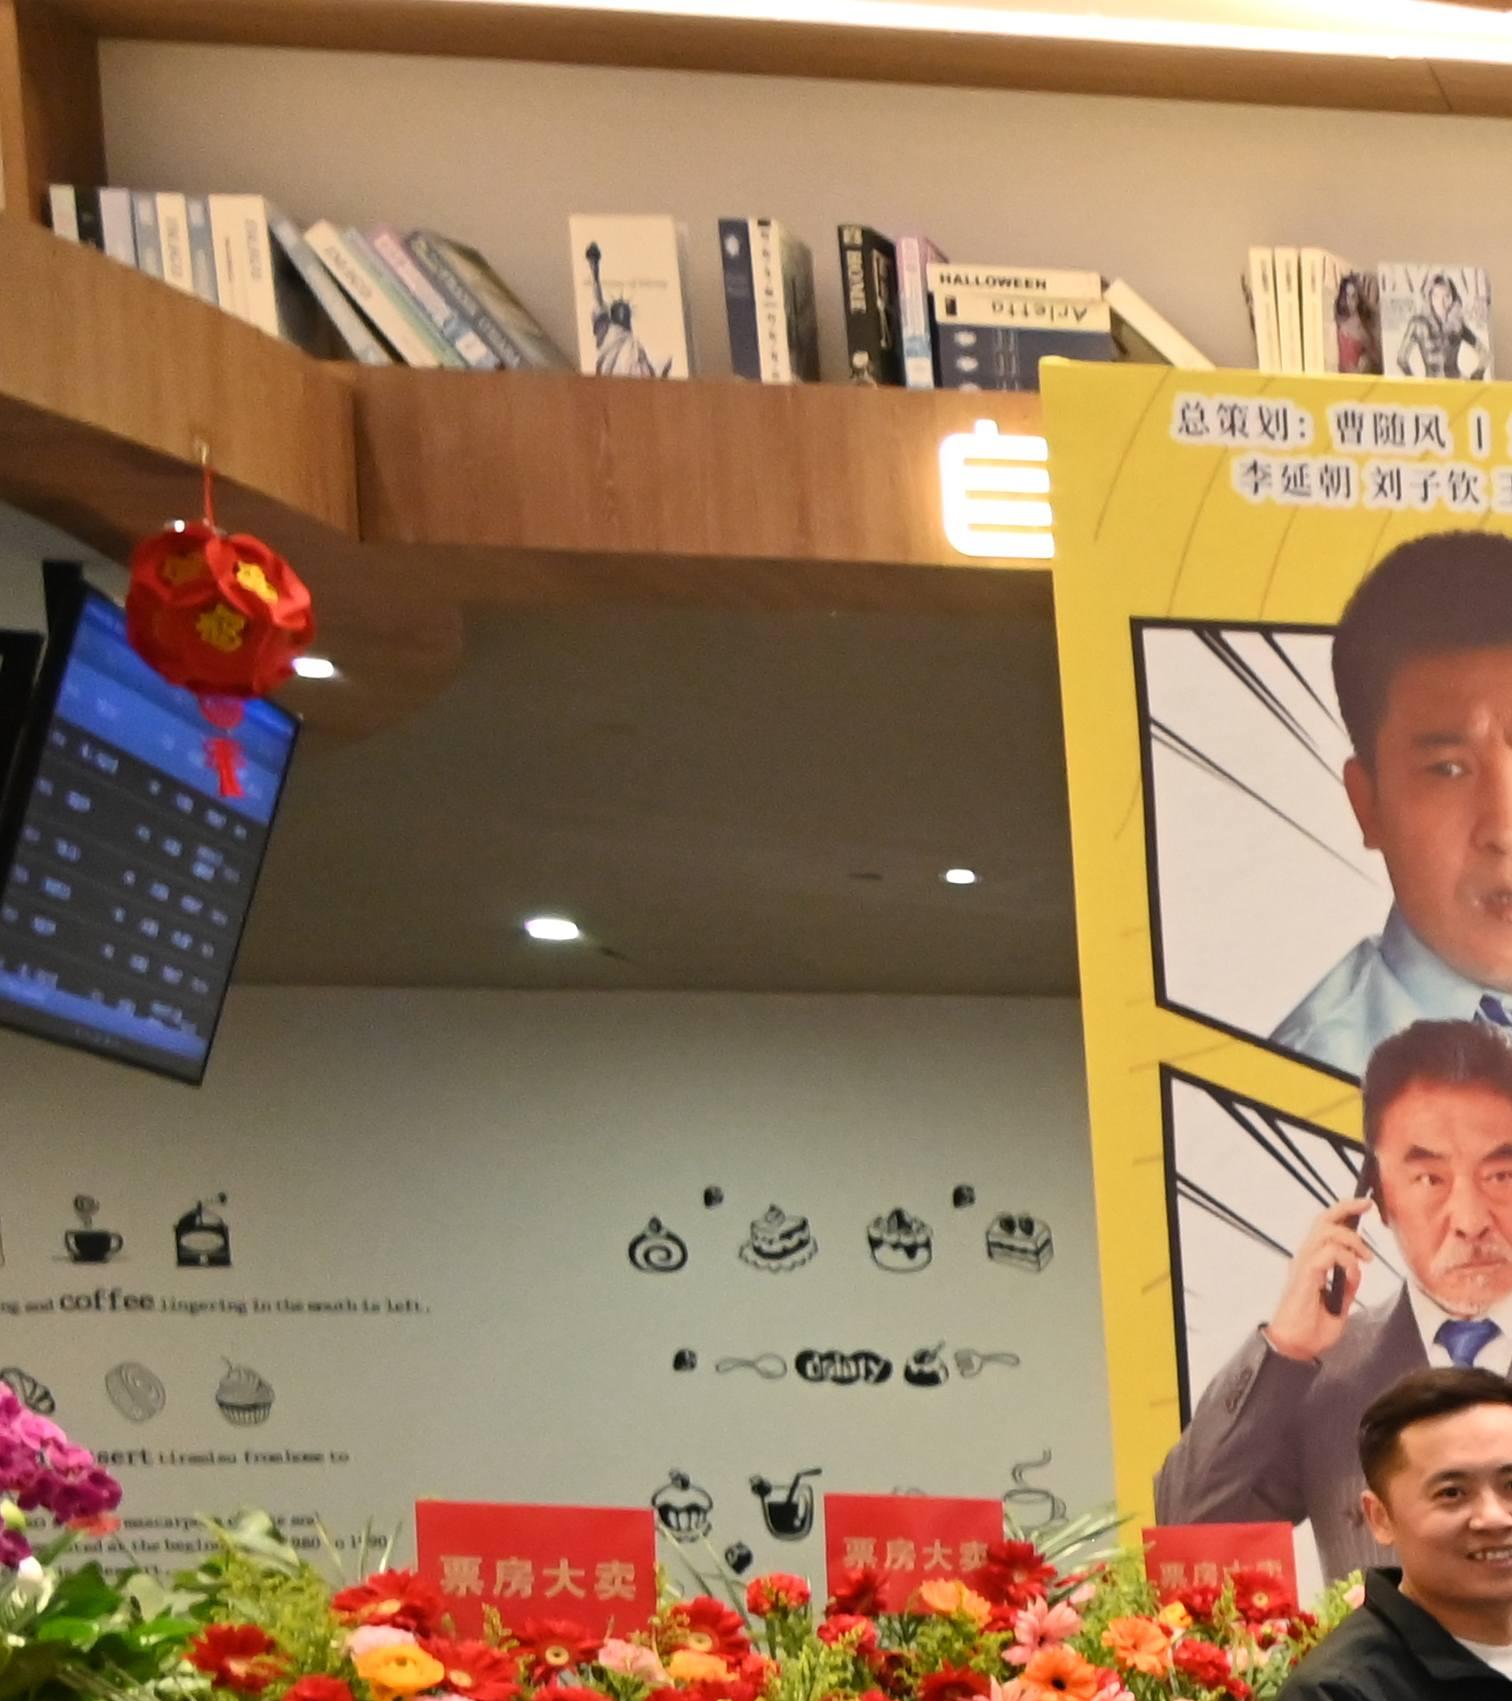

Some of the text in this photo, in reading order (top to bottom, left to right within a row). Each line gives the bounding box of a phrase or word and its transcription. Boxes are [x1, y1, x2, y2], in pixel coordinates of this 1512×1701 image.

[939, 272, 1047, 291] HALLOWEEN
[1177, 401, 1306, 443] 总策划：
[1336, 409, 1446, 449] 曹随风
[1239, 459, 1351, 500] 李延朝
[59, 1287, 155, 1312] coffee
[843, 1536, 989, 1571] 票房大卖
[438, 1554, 637, 1600] 票房大卖
